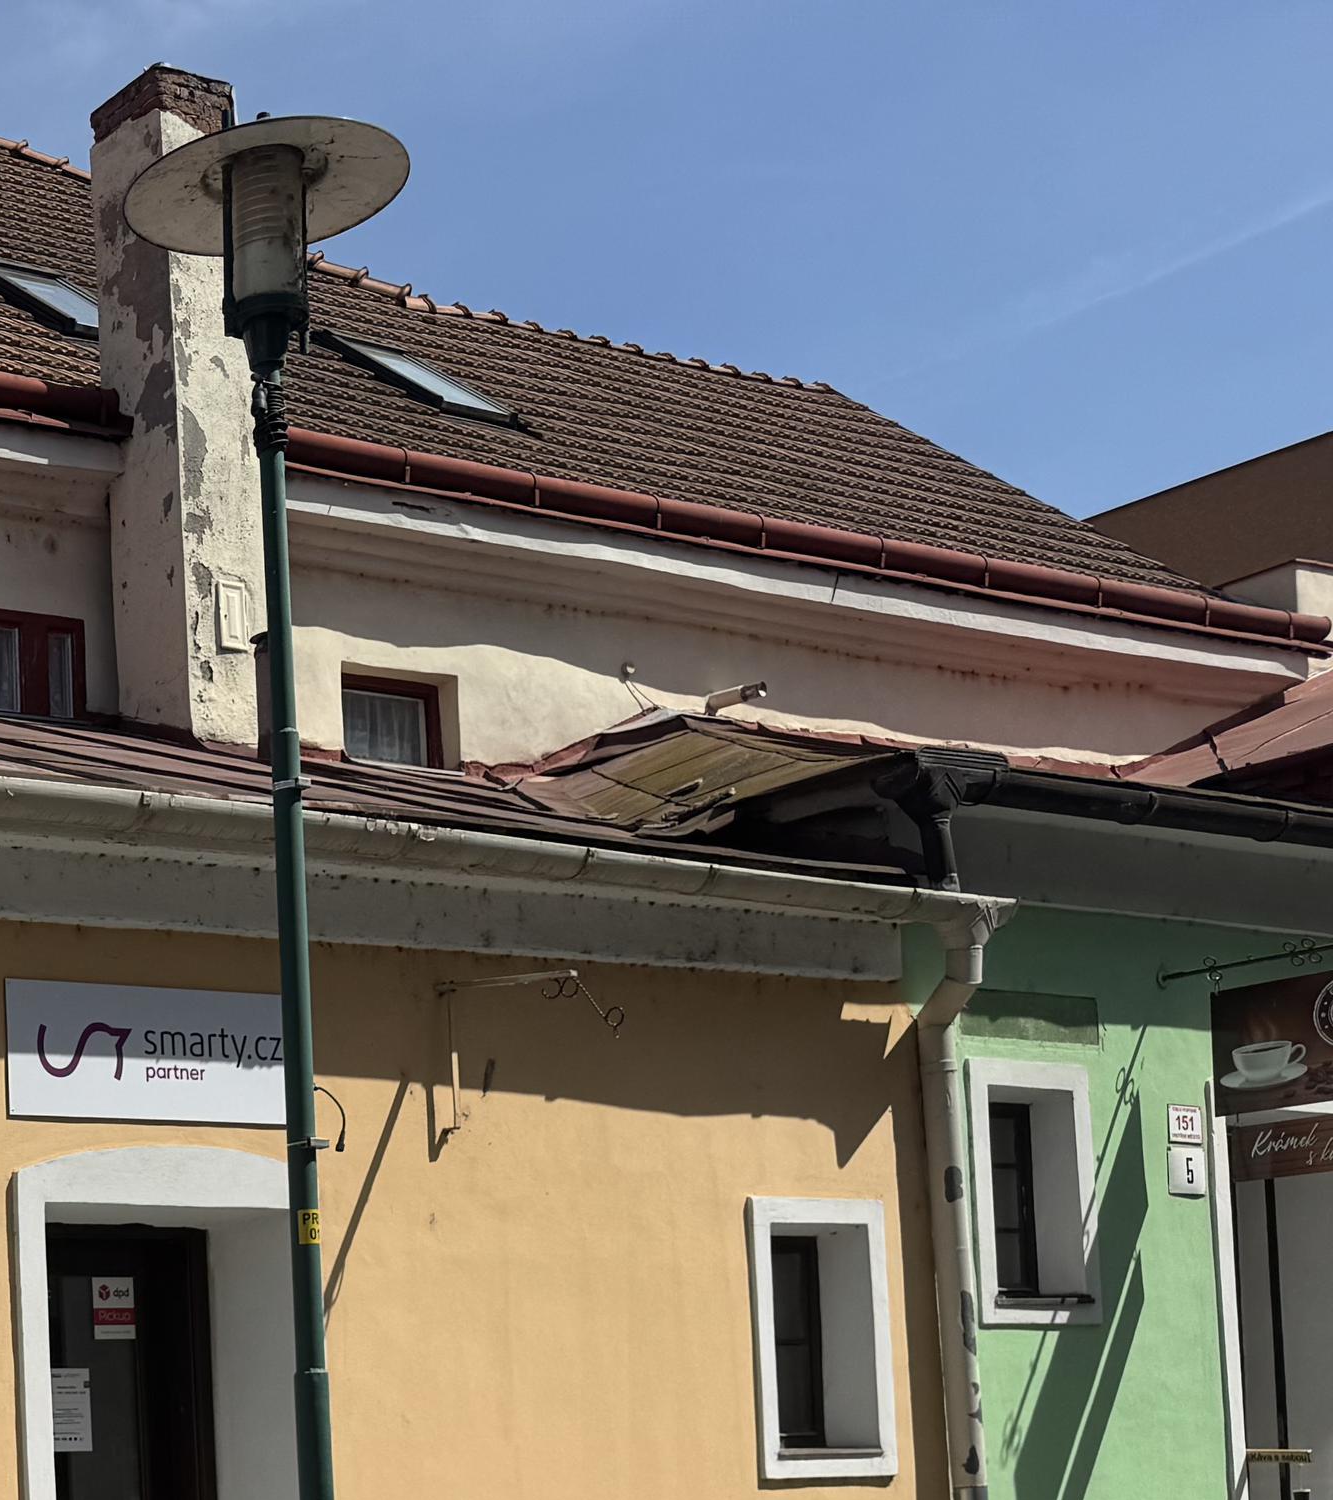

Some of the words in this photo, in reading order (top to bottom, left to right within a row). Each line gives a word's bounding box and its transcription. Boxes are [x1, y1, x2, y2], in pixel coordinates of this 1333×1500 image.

[143, 1027, 283, 1068] smarty.cz
[145, 1064, 206, 1082] partner
[1175, 1115, 1195, 1132] 151
[1251, 1122, 1319, 1159] Krámek
[1185, 1157, 1195, 1185] 5
